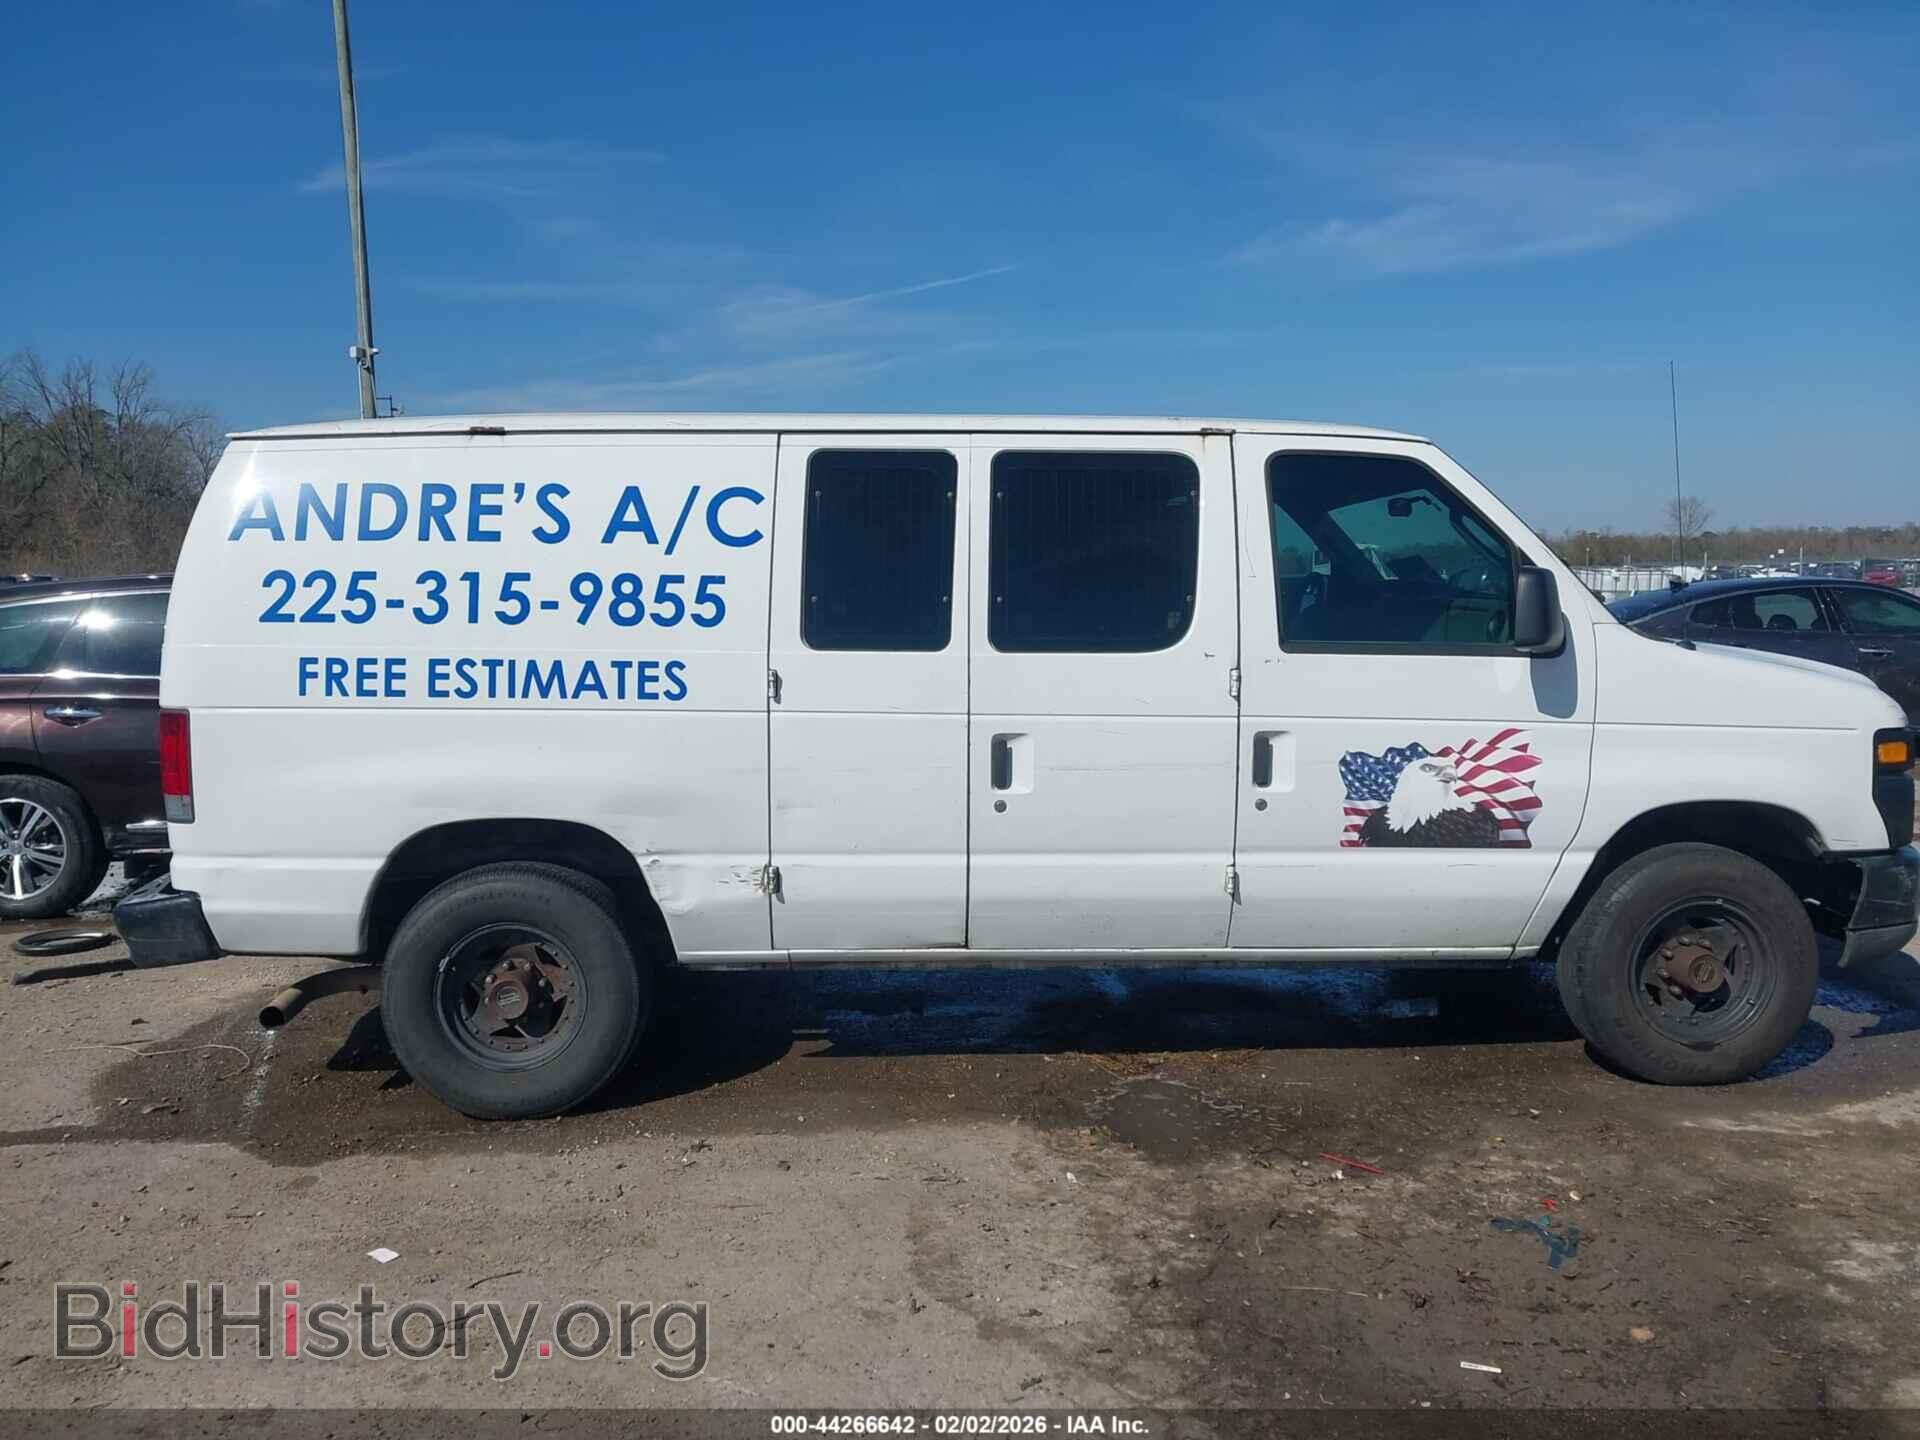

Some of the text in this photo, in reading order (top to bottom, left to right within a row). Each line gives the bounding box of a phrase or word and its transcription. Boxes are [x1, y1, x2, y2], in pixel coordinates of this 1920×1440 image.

[601, 484, 766, 556] A/C
[258, 569, 727, 628] 225-315-9855
[298, 656, 688, 701] FREE ESTIMATES
